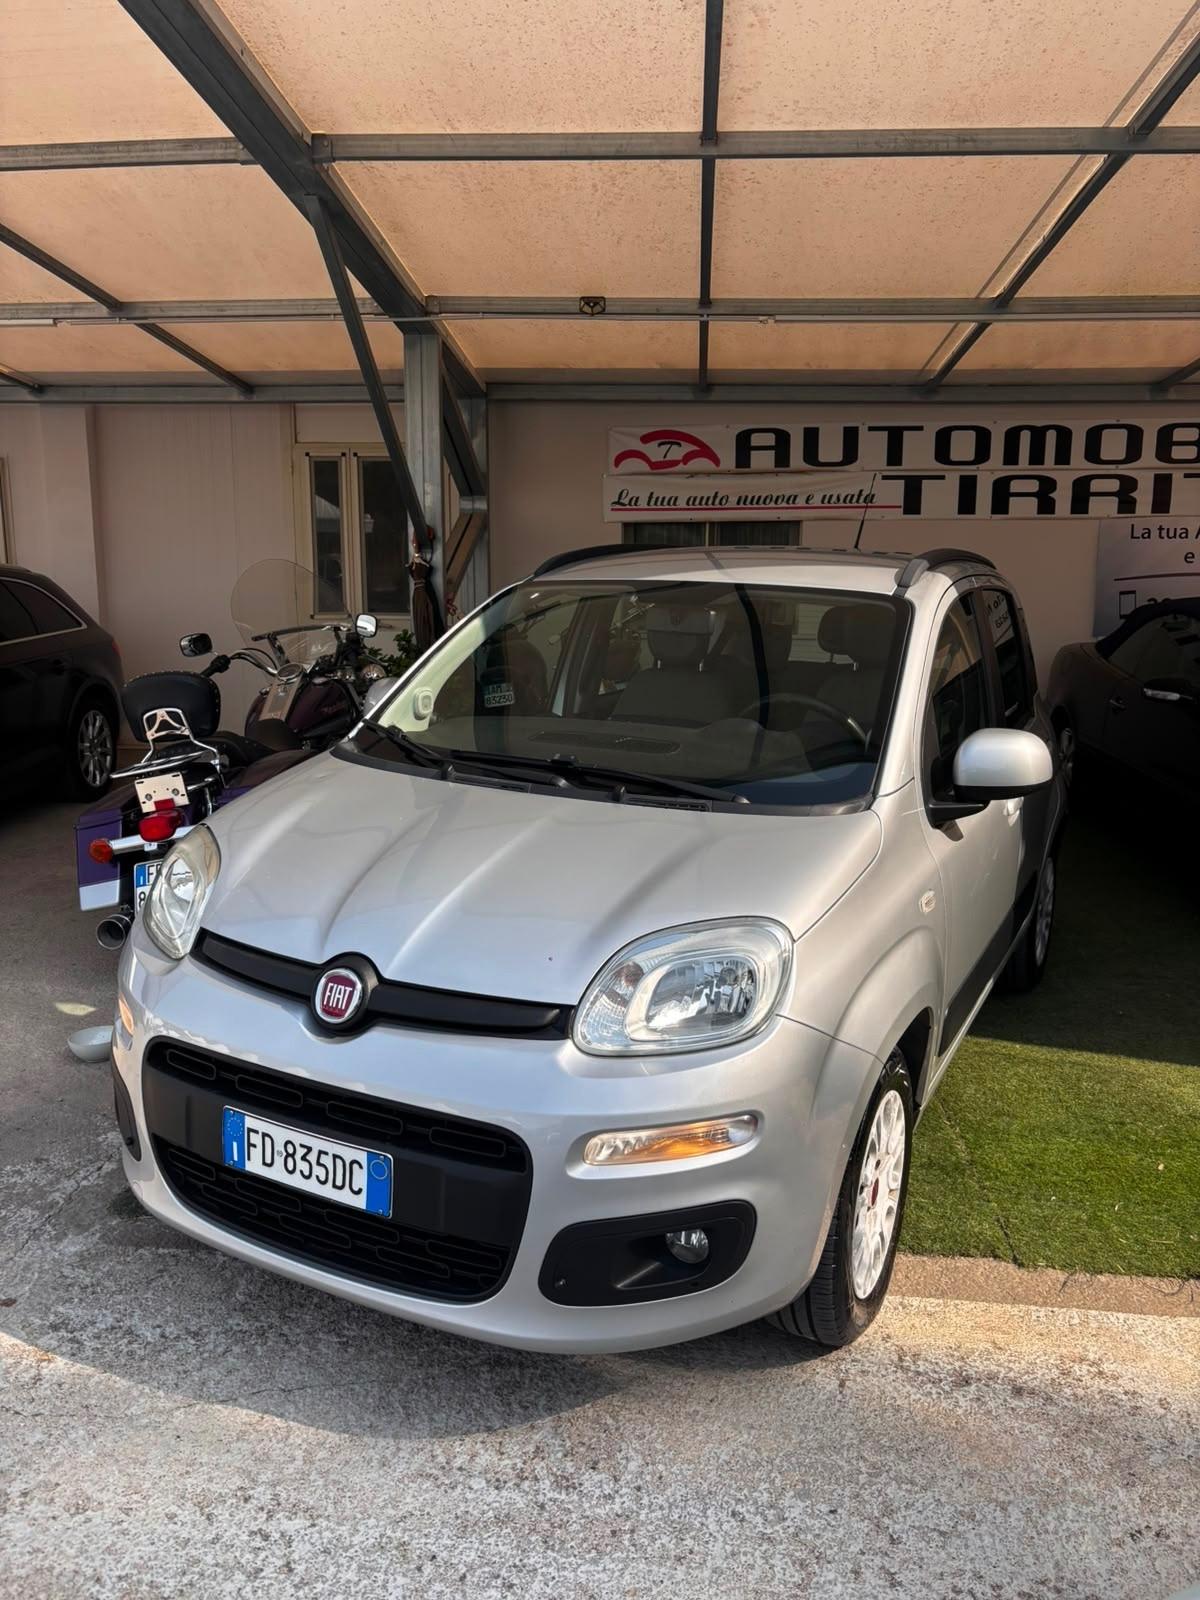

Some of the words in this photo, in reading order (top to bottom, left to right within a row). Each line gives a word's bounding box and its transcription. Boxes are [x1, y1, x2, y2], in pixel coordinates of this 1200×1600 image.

[735, 422, 1200, 468] AUTOMOB
[611, 488, 641, 507] La
[646, 490, 679, 507] tua
[685, 491, 729, 506] auto
[736, 494, 799, 506] nuova
[805, 494, 814, 505] e
[821, 489, 877, 505] usata
[1130, 523, 1151, 539] La
[1157, 525, 1189, 539] tua
[1184, 551, 1195, 564] e
[323, 982, 353, 1010] FIAT
